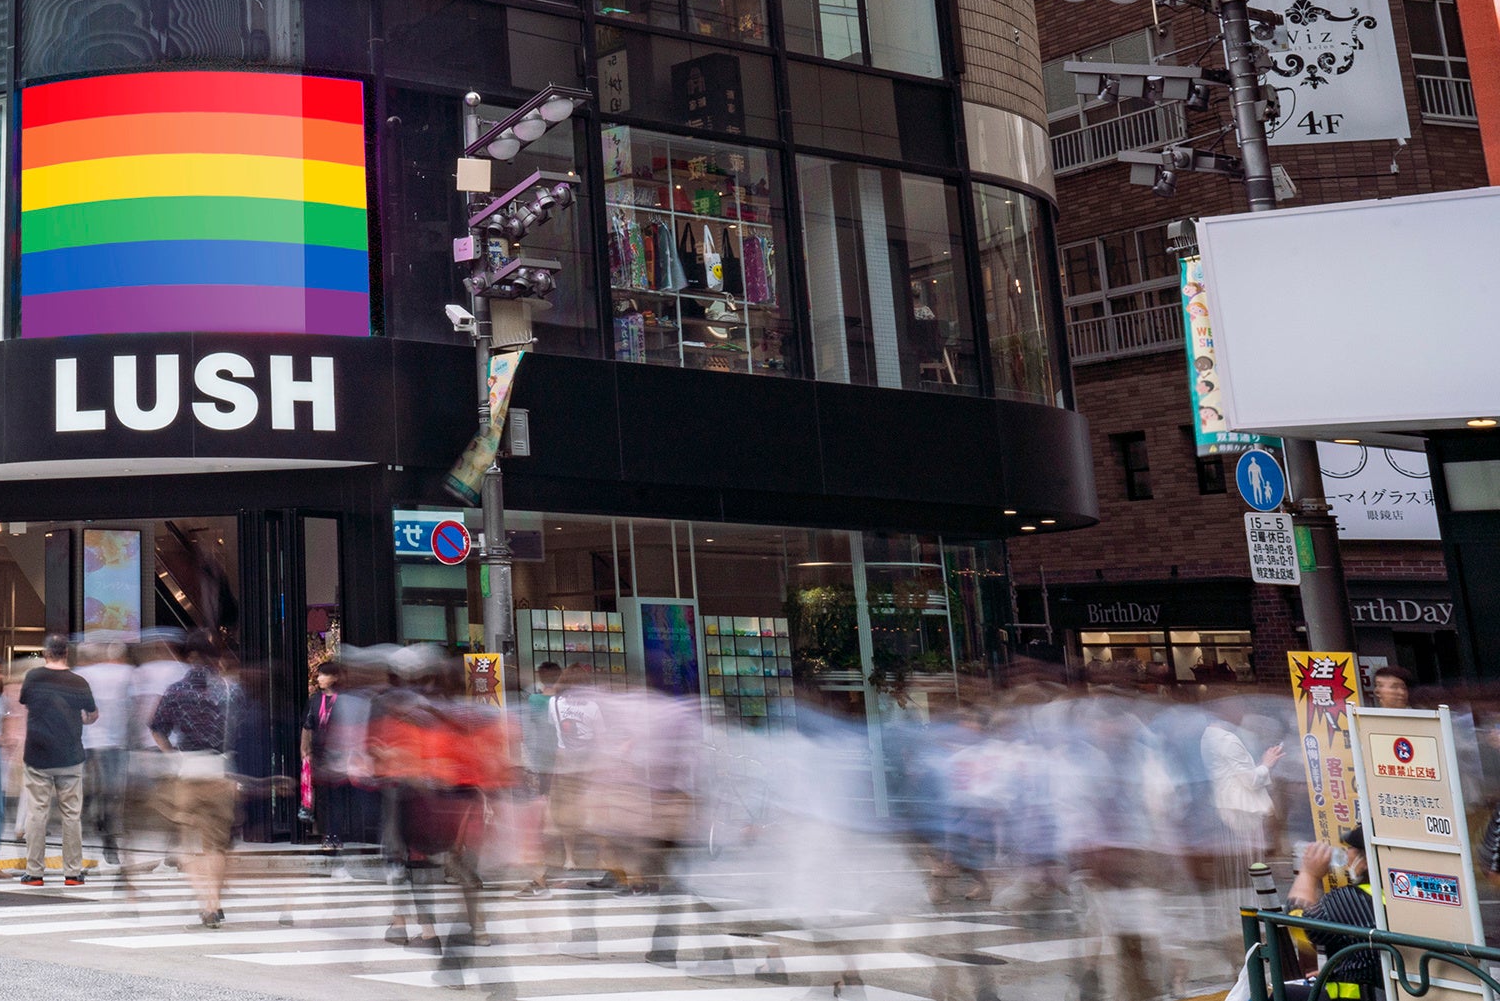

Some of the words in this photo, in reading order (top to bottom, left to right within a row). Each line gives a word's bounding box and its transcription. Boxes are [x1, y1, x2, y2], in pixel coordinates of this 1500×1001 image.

[1297, 110, 1344, 136] 4F
[55, 352, 336, 432] LUSH
[1366, 510, 1404, 521] 眼鏡店
[1087, 601, 1160, 624] BirthDay
[1351, 598, 1454, 625] rthDay
[1377, 764, 1437, 780] 放置禁止区域
[1426, 816, 1451, 835] CROD
